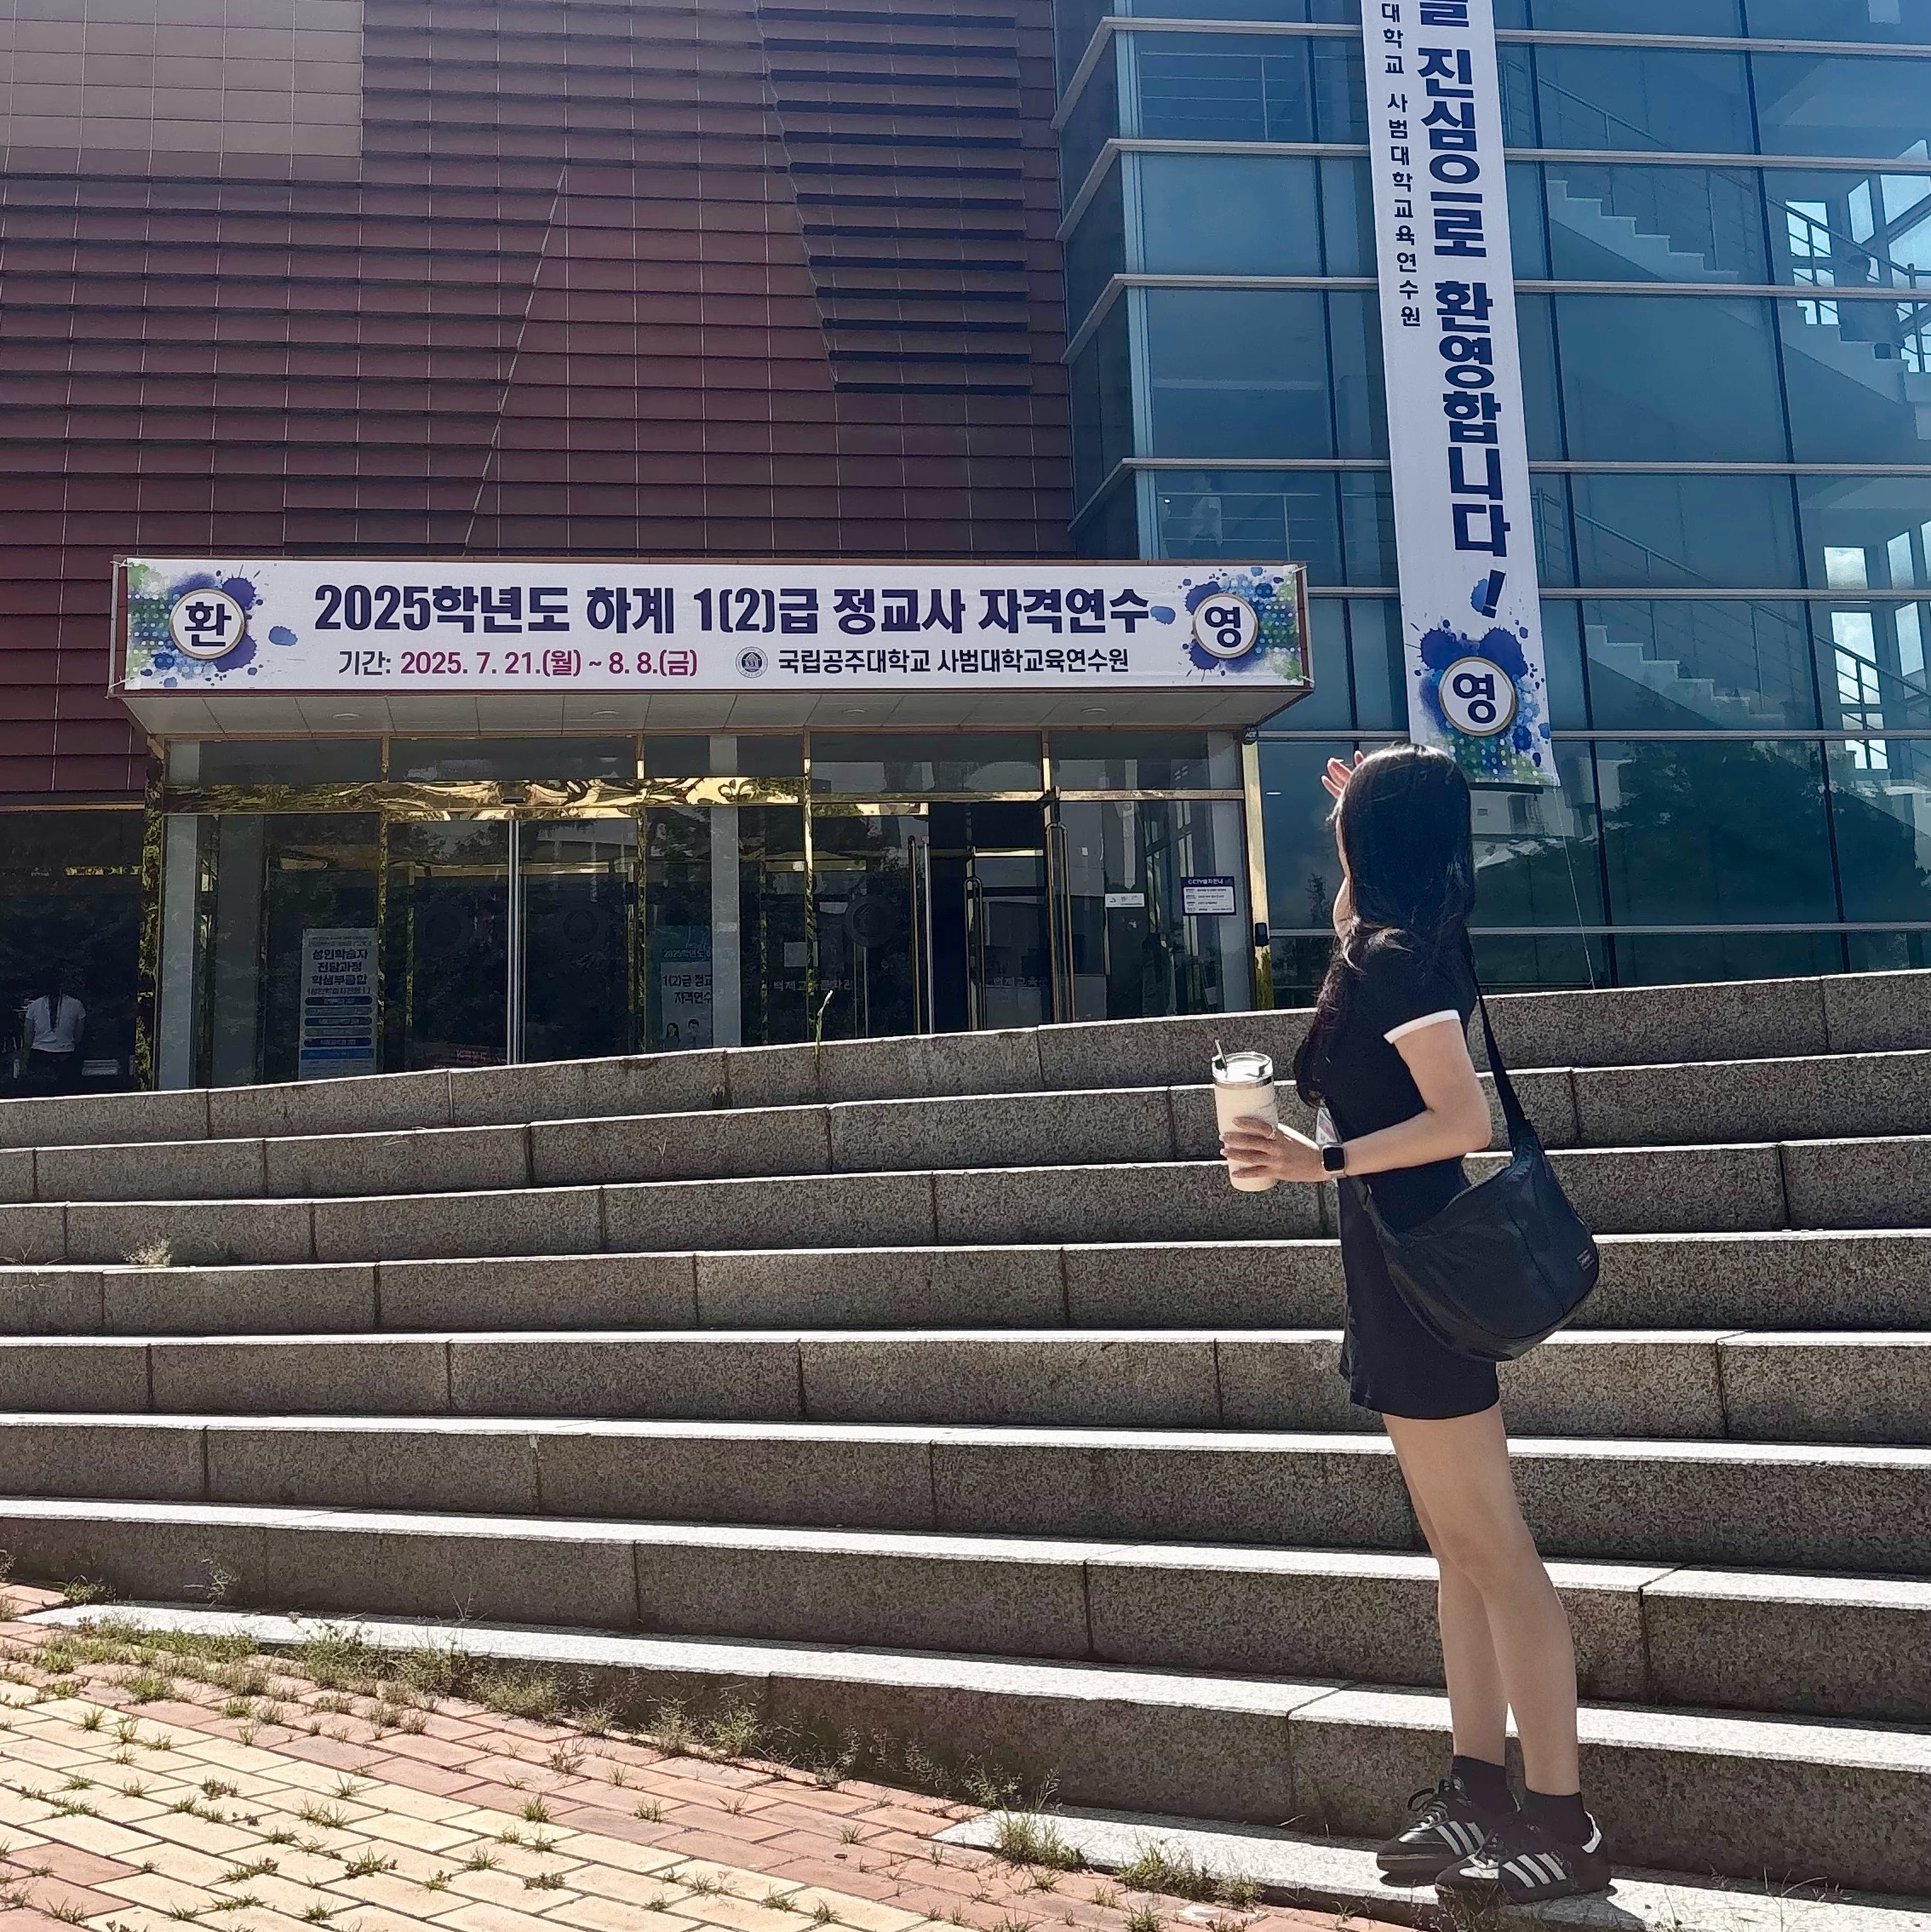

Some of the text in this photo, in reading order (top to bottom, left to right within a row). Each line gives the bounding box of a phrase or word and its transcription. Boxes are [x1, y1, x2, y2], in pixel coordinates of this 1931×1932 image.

[1382, 3, 1421, 327] 대학교 사범대학교육연수원
[1417, 47, 1487, 257] 진심으로
[1434, 280, 1511, 619] 환영합니다!
[184, 601, 232, 648] 환
[314, 583, 1150, 636] 2025학년도 하계 1(2)급 정교사 자격연수
[1205, 605, 1242, 648] 영
[338, 651, 392, 678] 기간:
[399, 652, 468, 676] 2025.
[477, 652, 498, 676] 7.
[504, 650, 582, 678] 21.(월)
[778, 648, 931, 674] 국립공주대학교
[938, 648, 1130, 674] 사범대학교육연수원
[1452, 672, 1497, 725] 영
[662, 974, 691, 987] 1(2)급
[673, 991, 713, 1005] 자격연수
